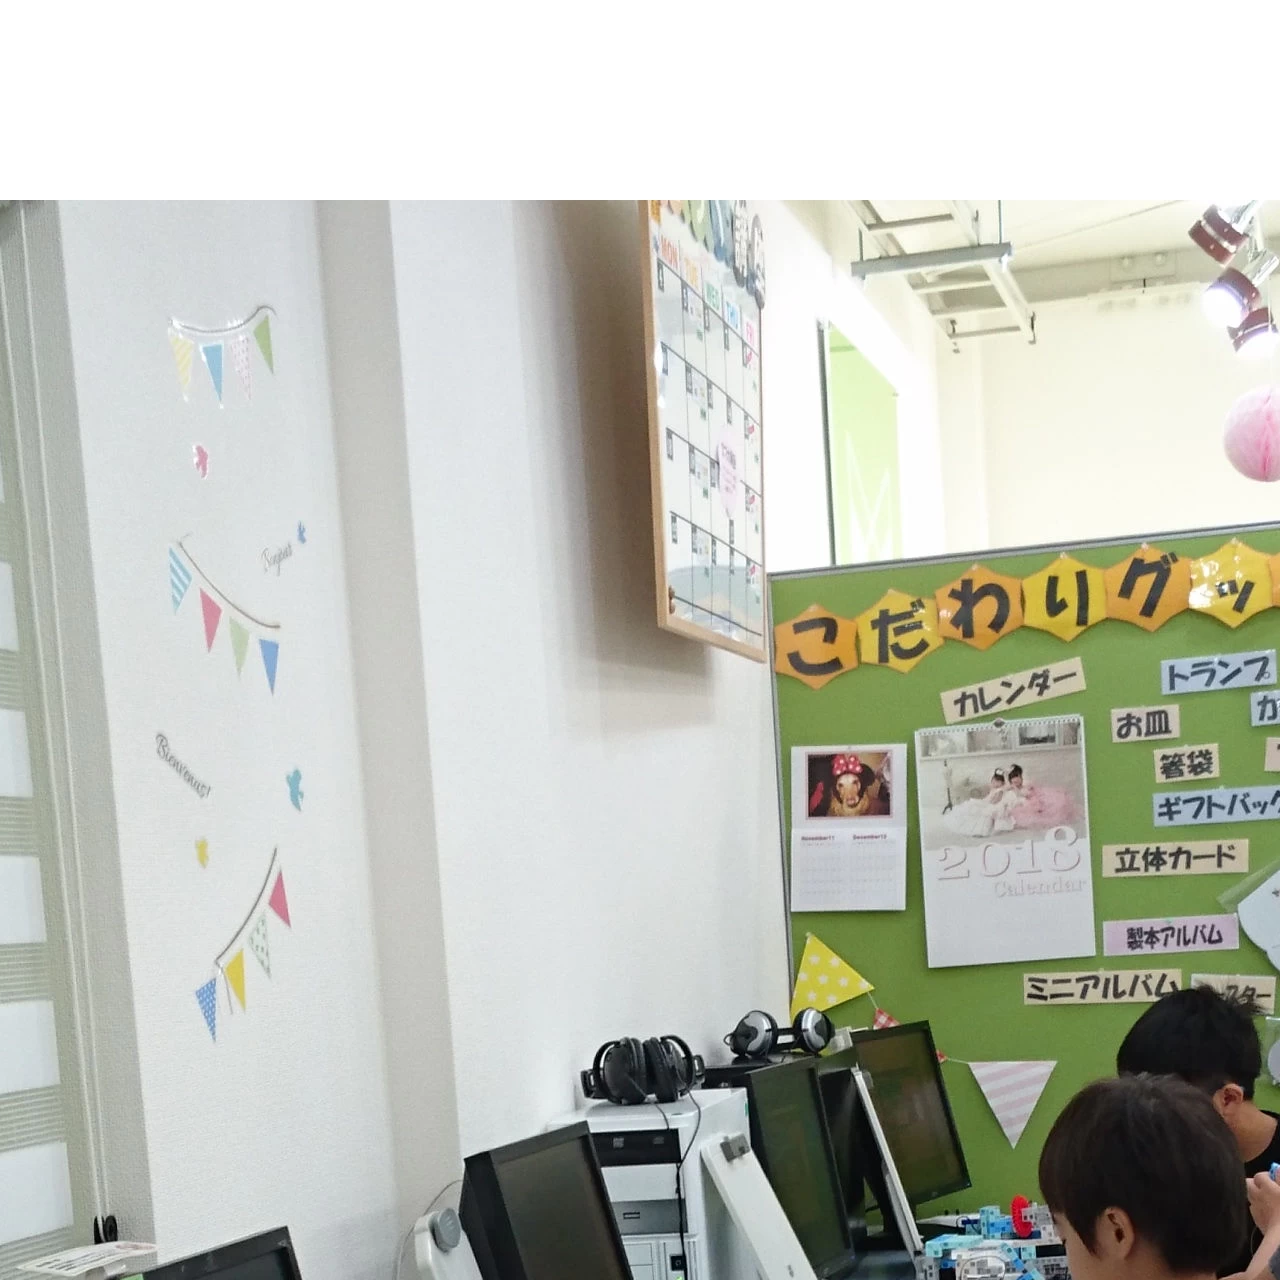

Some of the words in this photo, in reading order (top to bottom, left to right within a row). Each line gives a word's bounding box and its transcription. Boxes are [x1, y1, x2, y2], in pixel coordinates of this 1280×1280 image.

[1168, 655, 1272, 692] トランプ
[953, 668, 1078, 718] カレンダー
[1116, 709, 1172, 739] お皿
[938, 826, 1082, 881] 2018
[1114, 843, 1237, 873] 立体カード
[994, 876, 1088, 898] Calendar
[1126, 924, 1224, 950] 製本アルバム
[1026, 973, 1181, 1001] ミニアルバム
